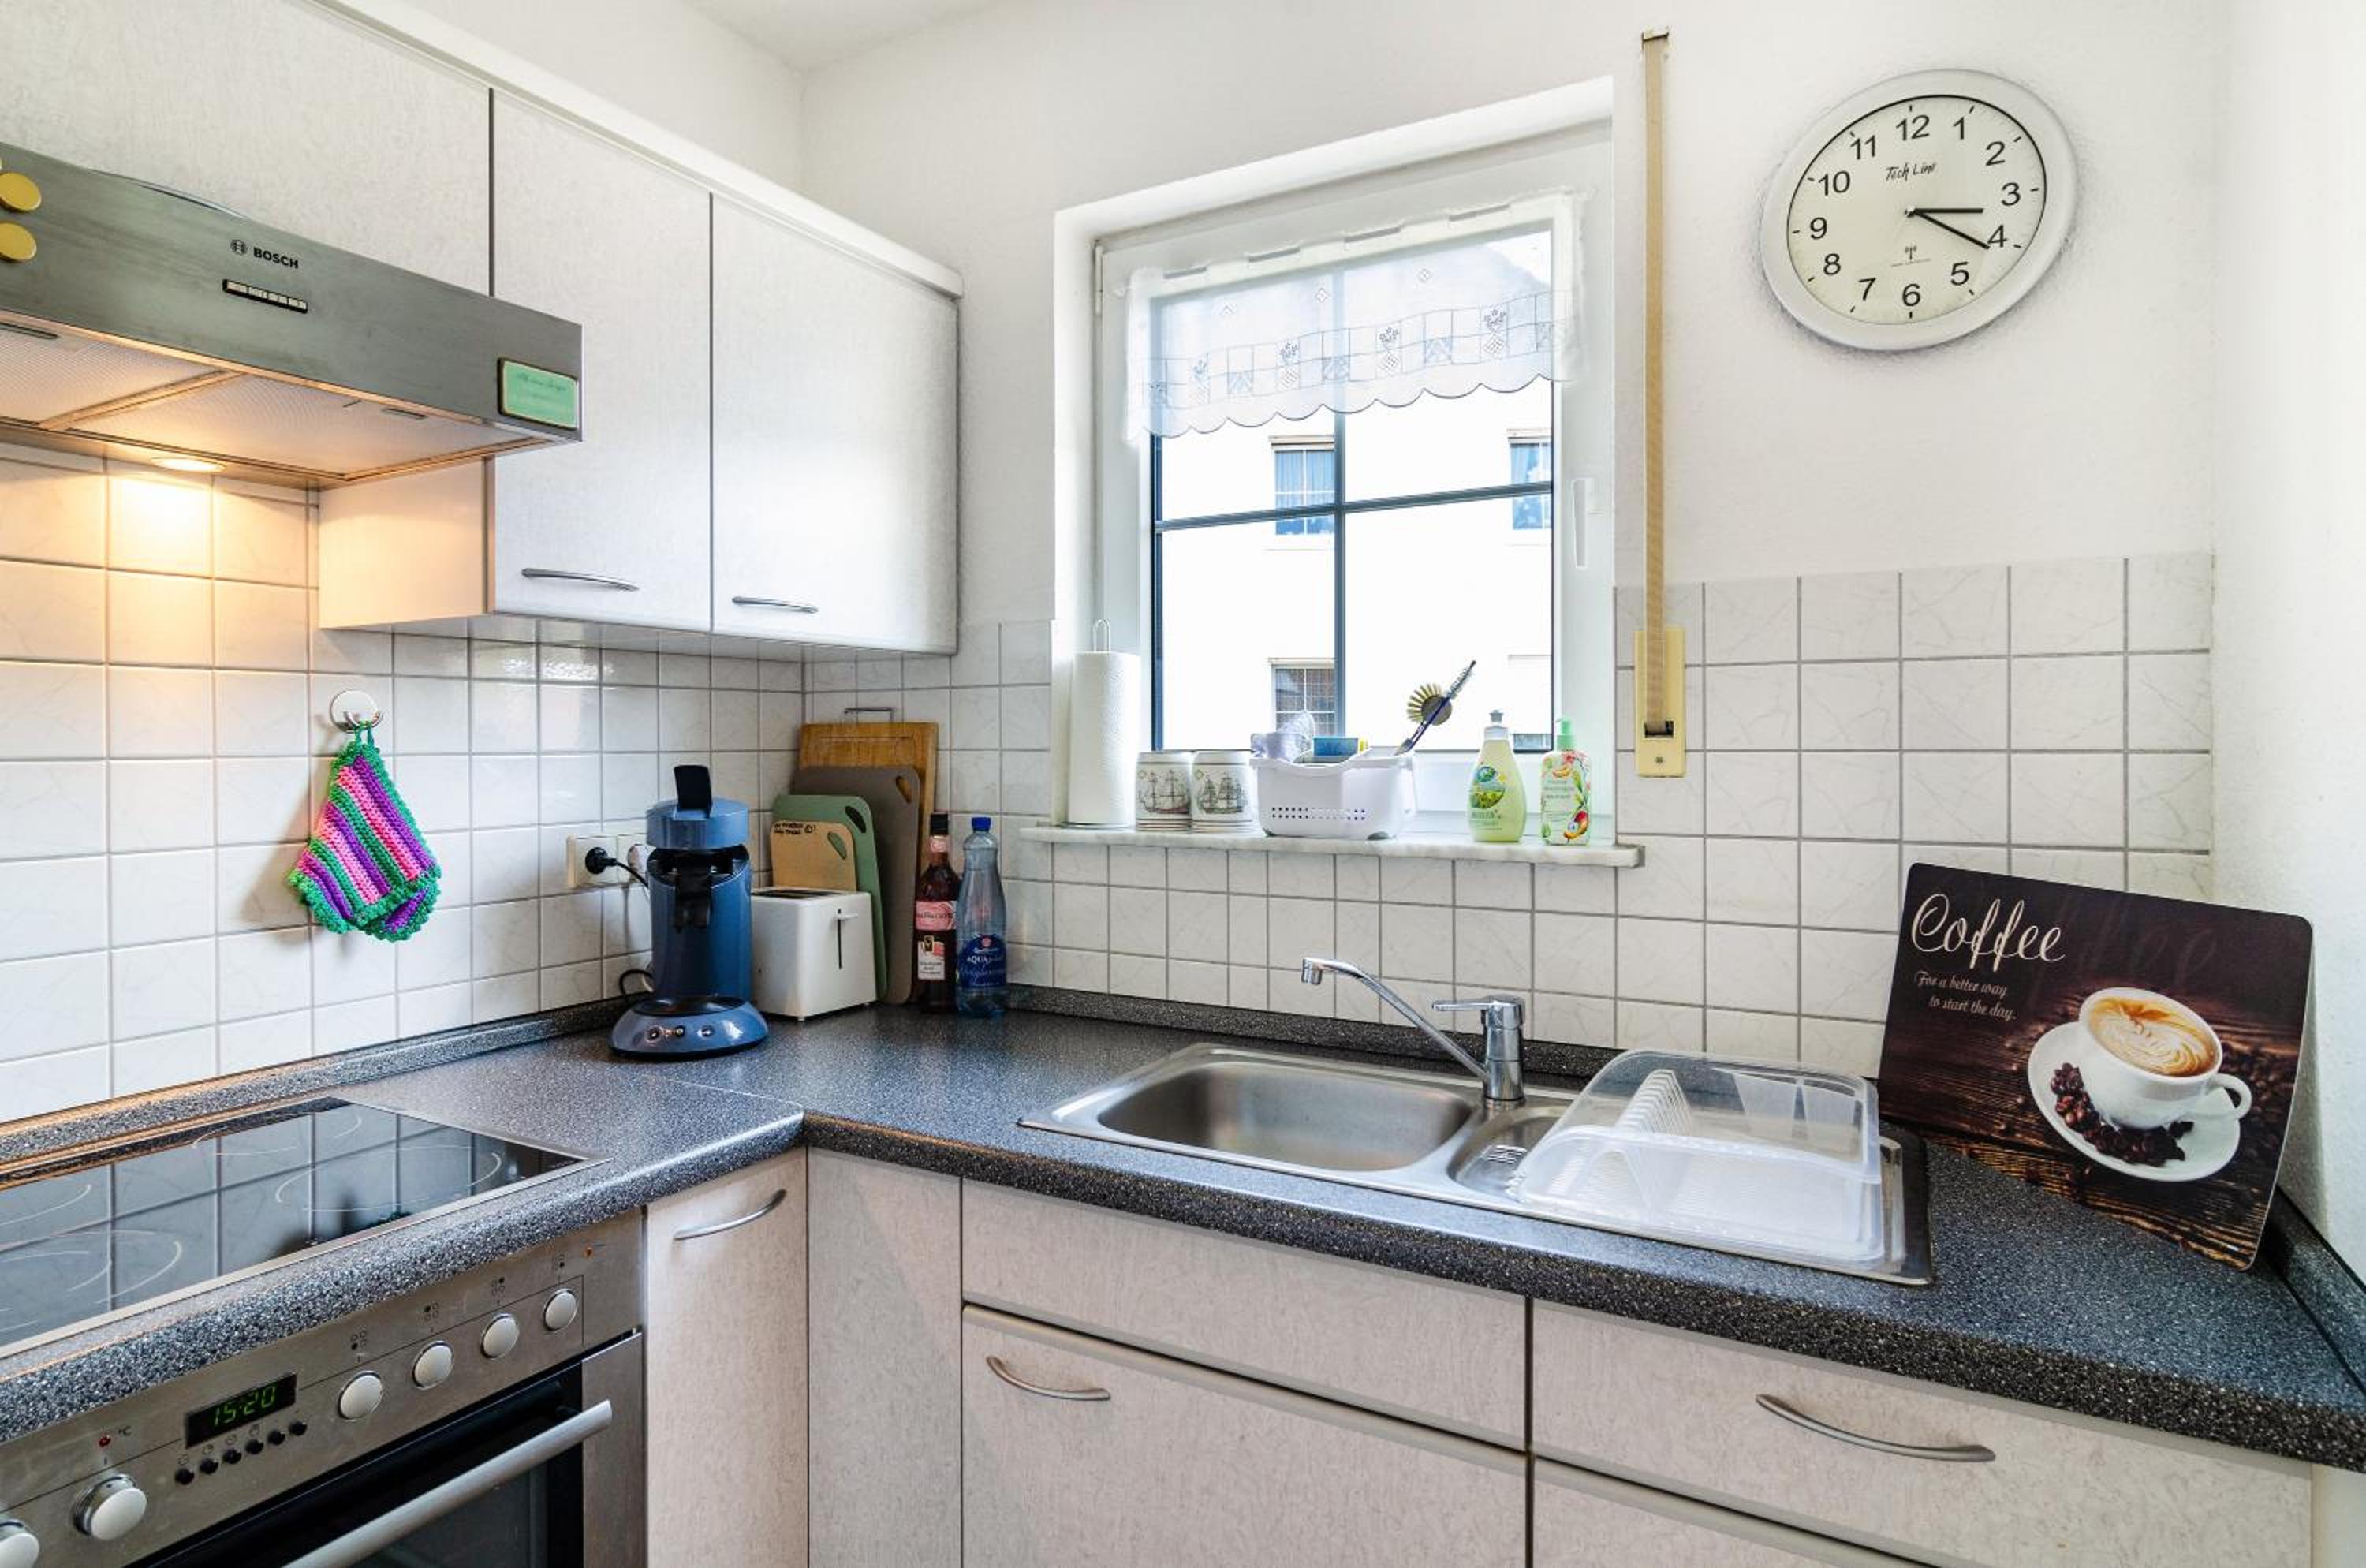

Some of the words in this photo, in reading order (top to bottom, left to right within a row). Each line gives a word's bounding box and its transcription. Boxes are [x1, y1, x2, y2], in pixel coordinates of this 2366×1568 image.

[1895, 114, 1930, 141] 12
[1953, 117, 1965, 140] 1
[1850, 135, 1875, 160] 11
[1985, 141, 2006, 166] 2
[1818, 170, 1851, 196] 10
[2001, 182, 2021, 207] 3
[1809, 217, 1827, 240] 9
[1987, 224, 2008, 248] 4
[253, 246, 300, 269] BOSCH
[1823, 253, 1842, 276] 8
[1950, 261, 1970, 286] 5
[1858, 277, 1876, 301] 7
[1901, 283, 1921, 307] 6
[1911, 893, 2066, 973] Coffee
[1914, 970, 1938, 987] For
[1939, 978, 1947, 988] a
[1950, 975, 1980, 992] better
[1980, 984, 2007, 999] way
[1929, 995, 1940, 1008] to
[1942, 997, 1969, 1011] start
[1971, 999, 1987, 1015] the
